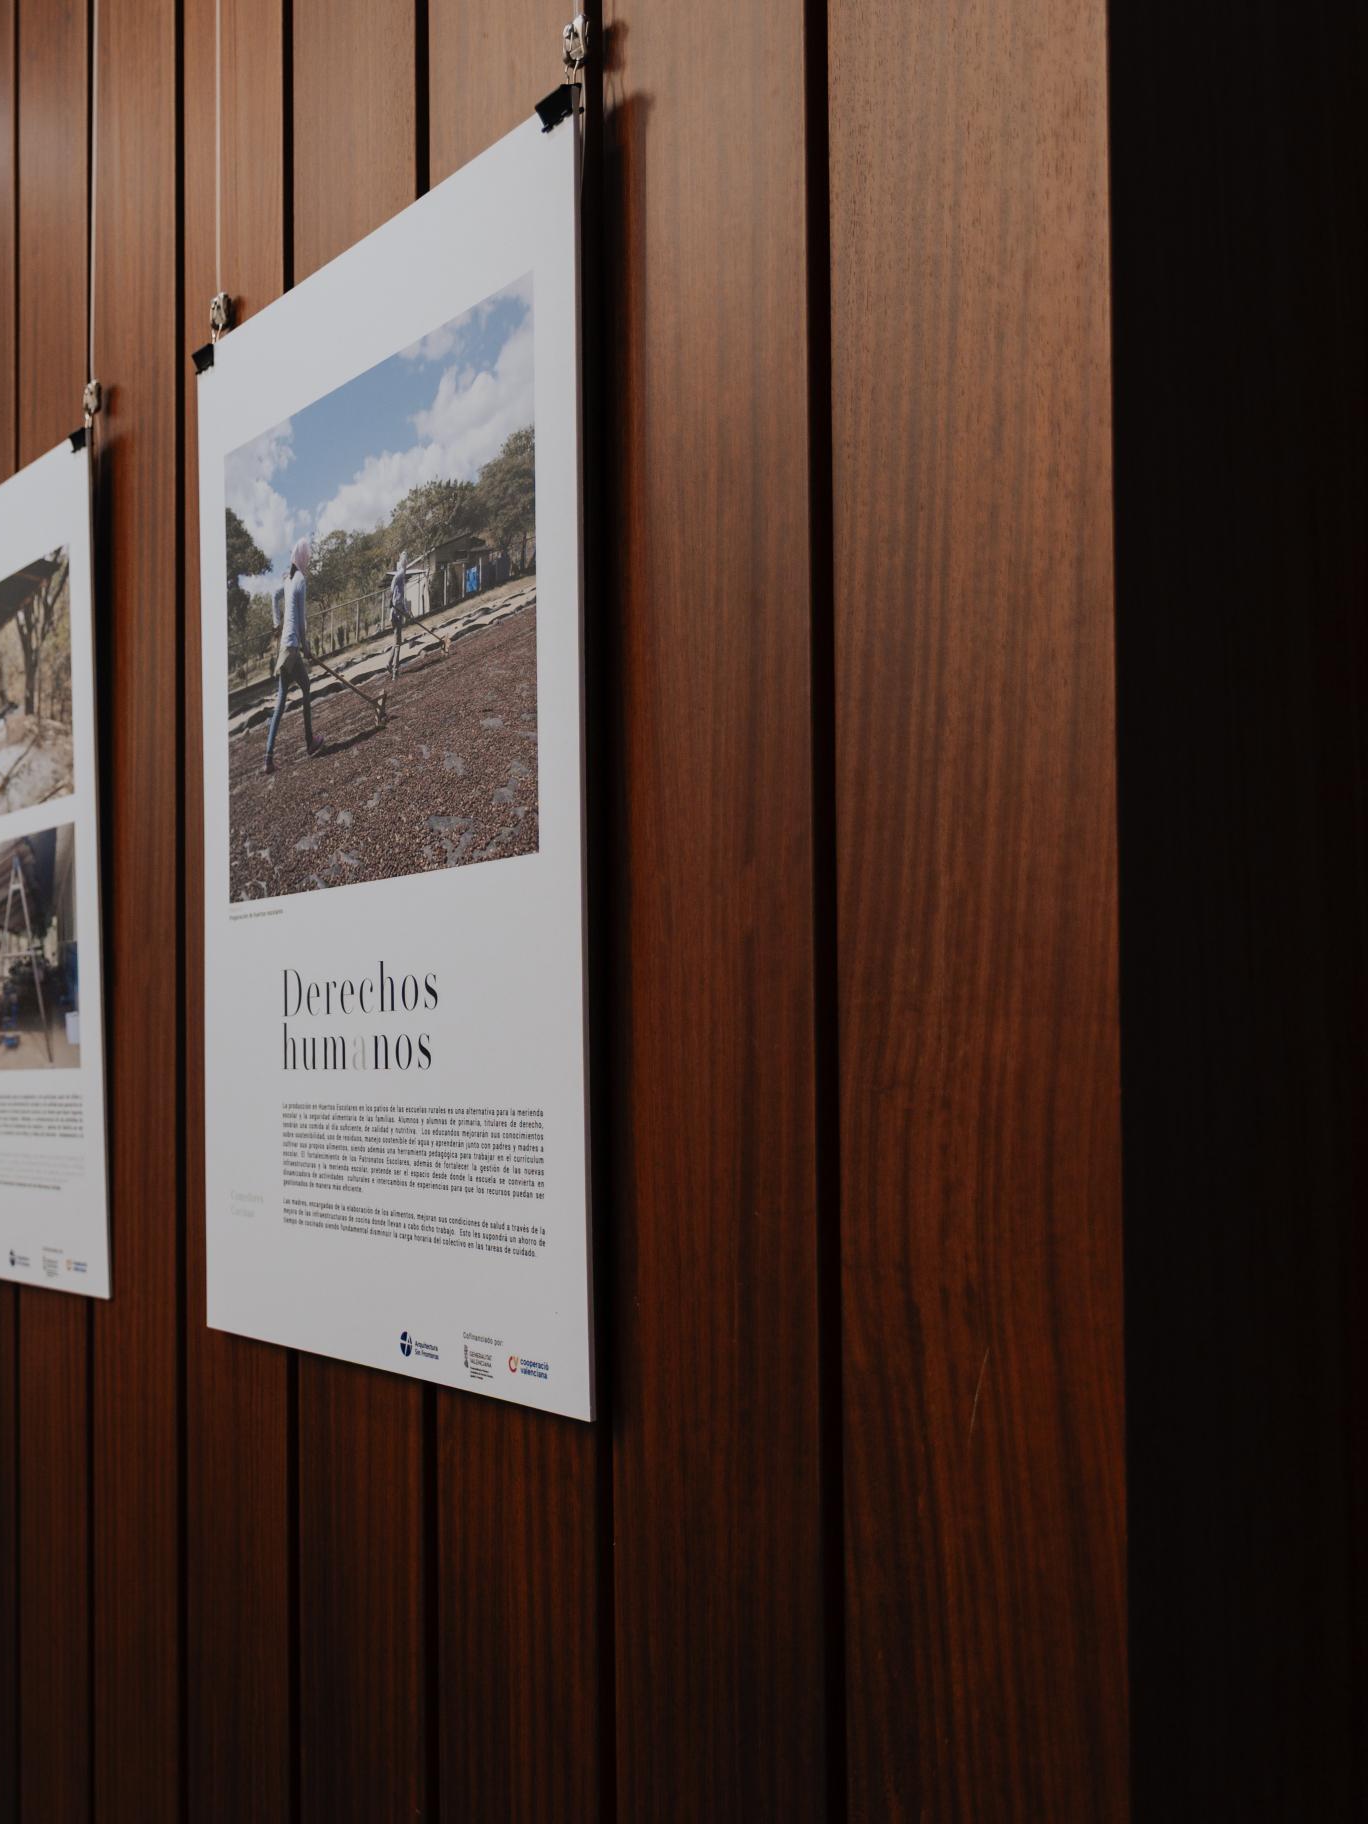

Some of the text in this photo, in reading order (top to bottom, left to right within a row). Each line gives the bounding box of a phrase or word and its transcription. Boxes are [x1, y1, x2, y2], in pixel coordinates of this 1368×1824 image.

[282, 961, 438, 1017] Derechos
[282, 1022, 432, 1071] humanos
[444, 1161, 469, 1170] fortalecer
[513, 1166, 521, 1174] las
[449, 1218, 480, 1227] condiciones
[512, 1225, 529, 1233] través
[459, 1229, 471, 1237] Esto
[482, 1233, 508, 1242] supondrá
[518, 1236, 537, 1245] ahorro
[442, 1238, 466, 1247] colectivo
[476, 1242, 484, 1250] las
[463, 1332, 493, 1344] Cofinanciado
[520, 1358, 549, 1371] cooperació
[520, 1368, 548, 1380] valenciana
